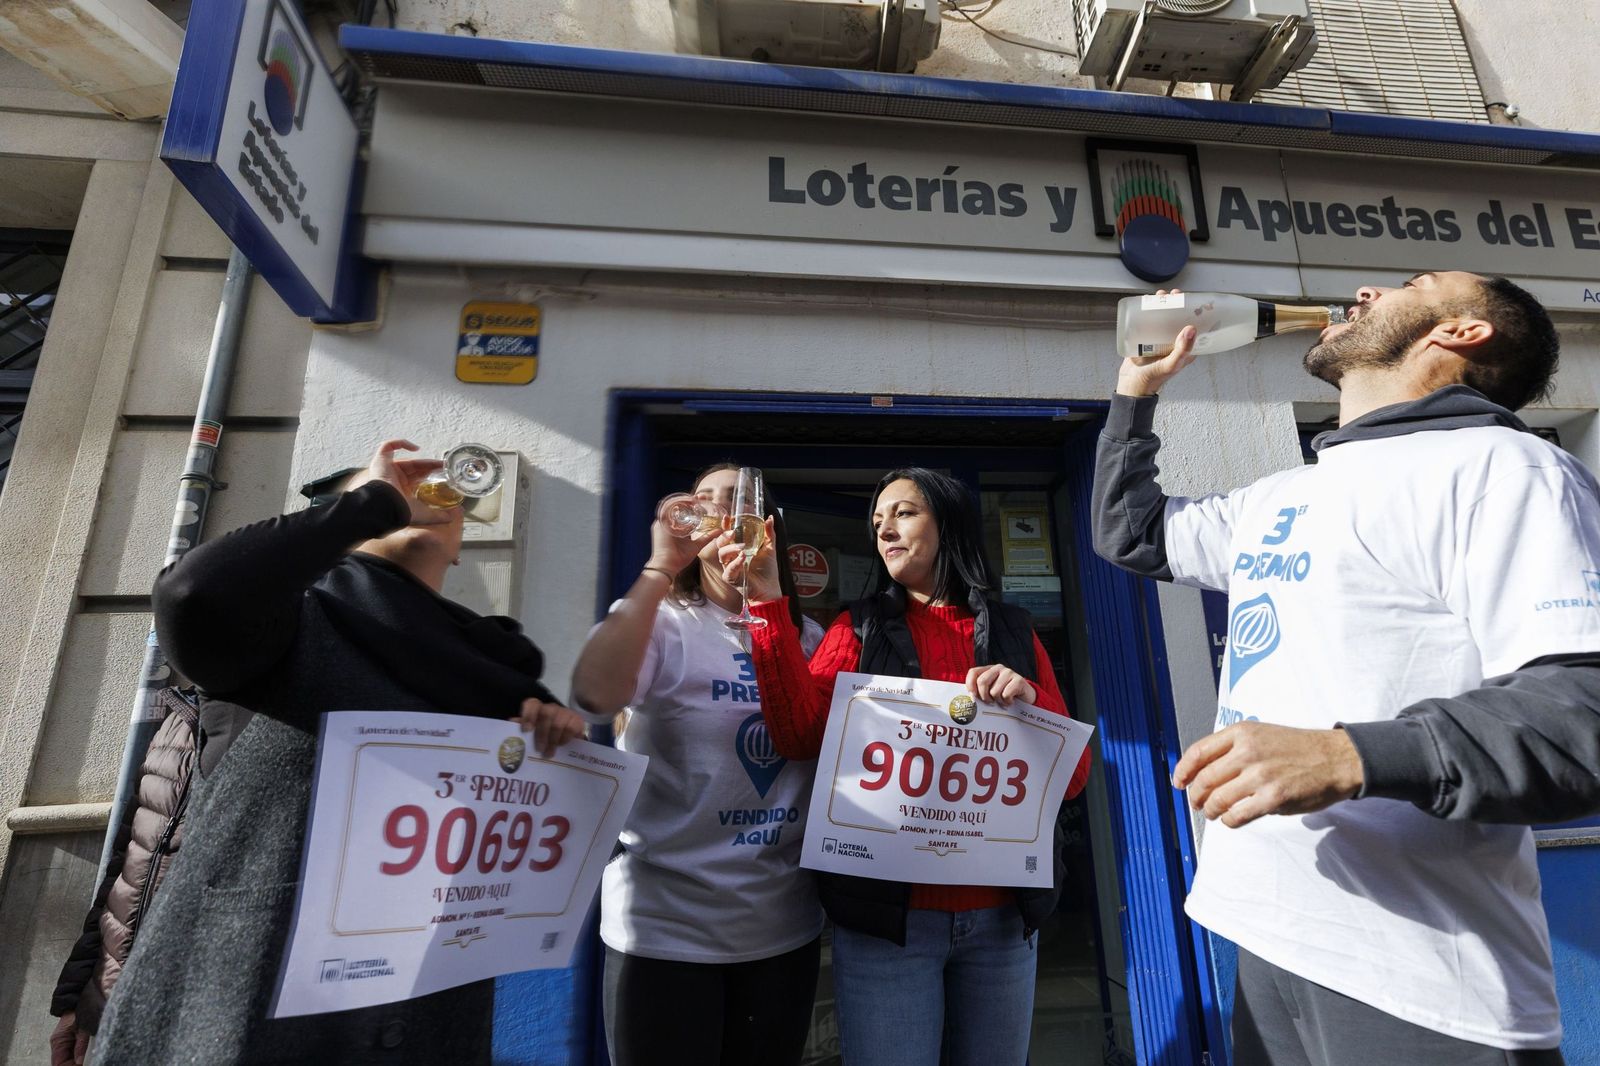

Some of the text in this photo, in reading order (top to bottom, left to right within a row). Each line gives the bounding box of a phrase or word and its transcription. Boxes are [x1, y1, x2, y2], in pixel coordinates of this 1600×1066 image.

[767, 155, 1600, 250] Loterías y Apuestas del E
[788, 549, 817, 568] +18
[1232, 550, 1312, 582] PREMIO
[732, 652, 756, 682] 3
[925, 723, 1009, 753] PREMIO
[858, 740, 1030, 807] 90693
[469, 773, 550, 807] PREMIO
[717, 806, 800, 826] VENDIDO
[899, 804, 987, 826] VENDIDO AQUÍ
[379, 803, 571, 876] 90693
[731, 825, 783, 847] AQUÍ
[900, 824, 928, 835] ADMON.
[946, 829, 964, 837] REINA
[965, 830, 984, 838] ISABEL
[837, 848, 875, 860] NACIONAL
[928, 840, 950, 848] SANTA
[432, 885, 487, 904] VENDIDO
